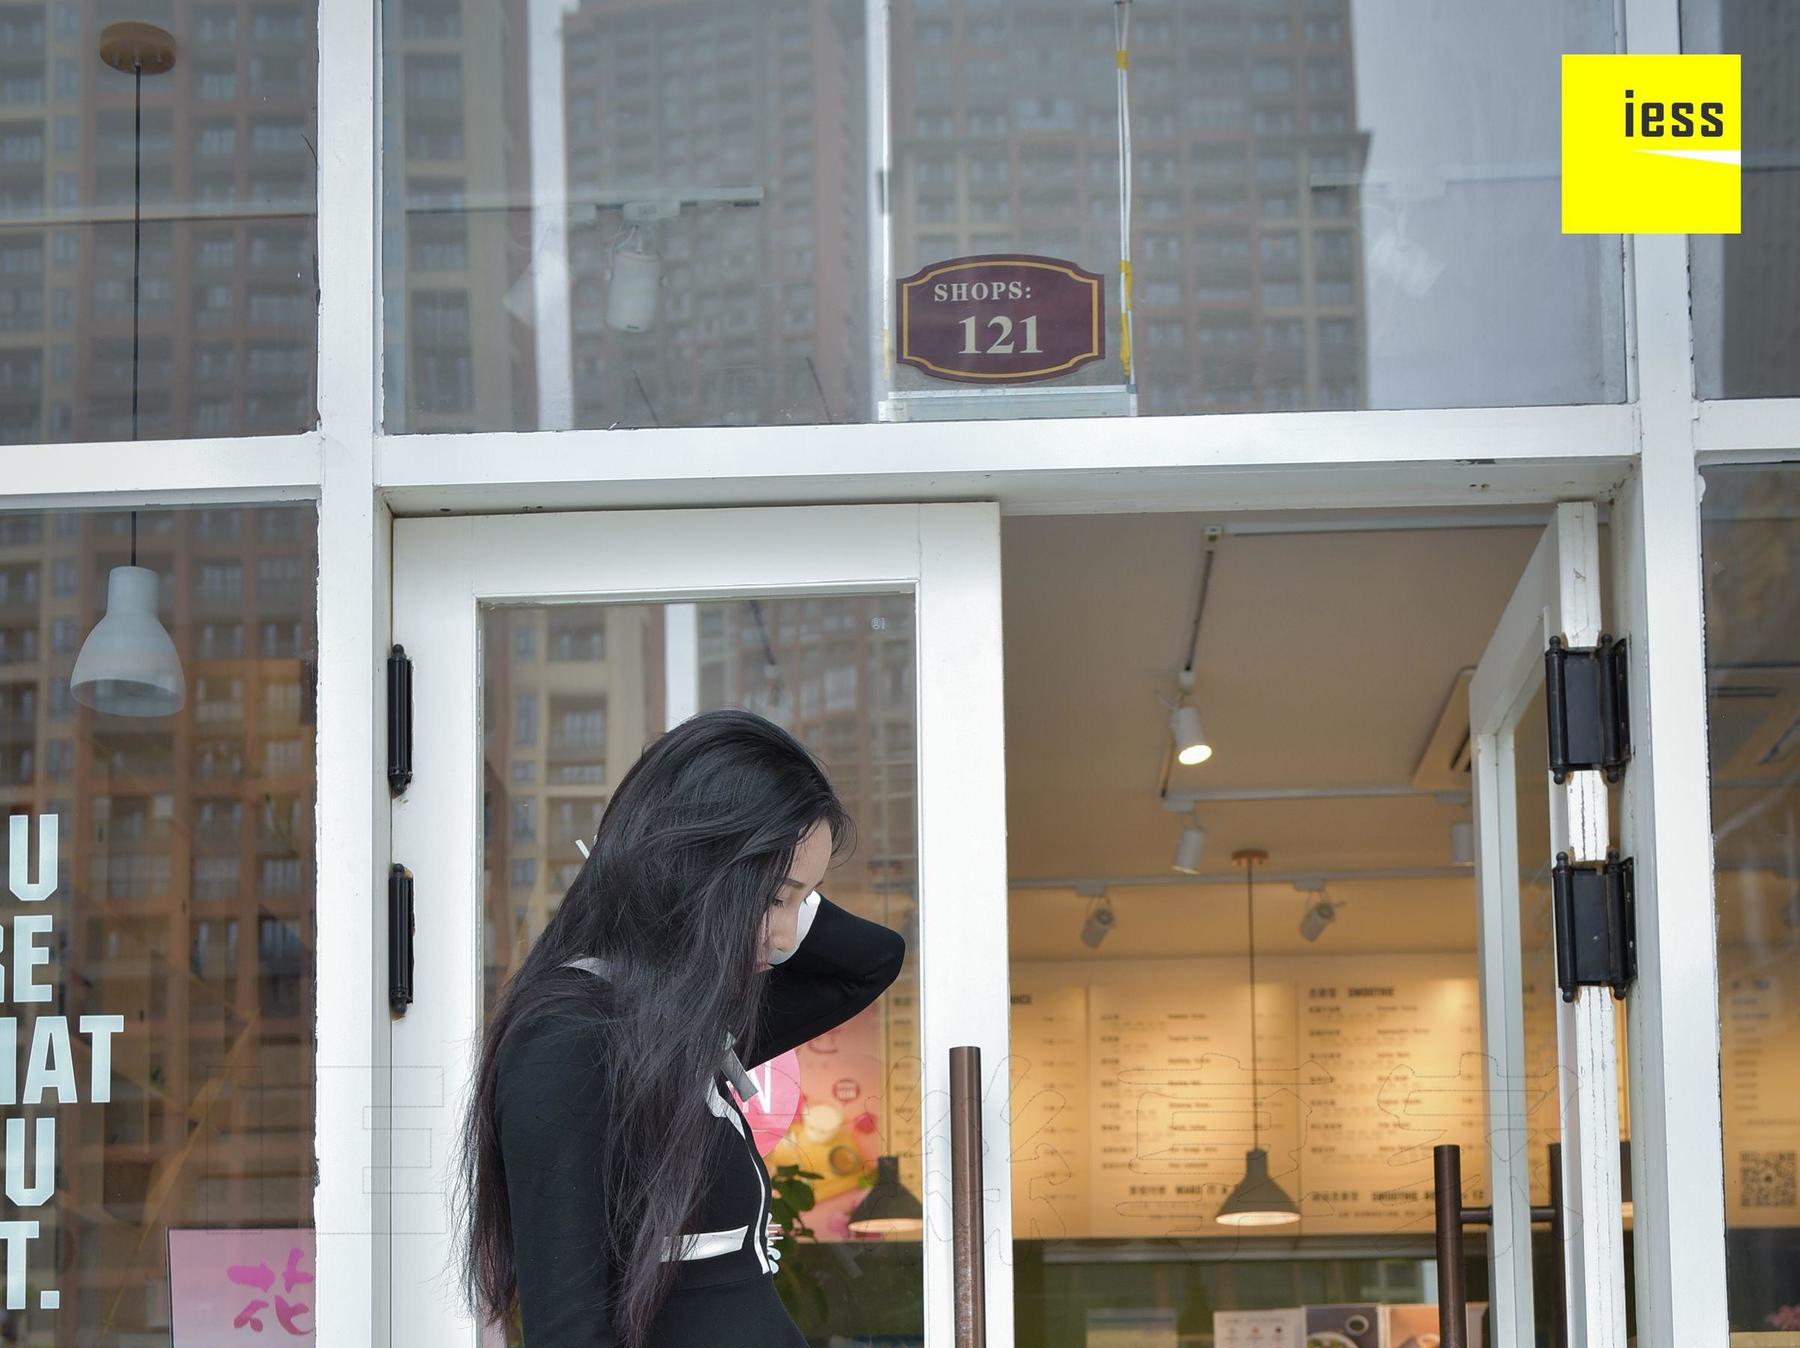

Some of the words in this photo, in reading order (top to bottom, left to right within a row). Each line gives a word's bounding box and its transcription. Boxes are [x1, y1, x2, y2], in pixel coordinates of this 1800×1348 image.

[934, 281, 1032, 302] SHOPS:
[958, 315, 1043, 355] 121
[0, 915, 53, 1003] E
